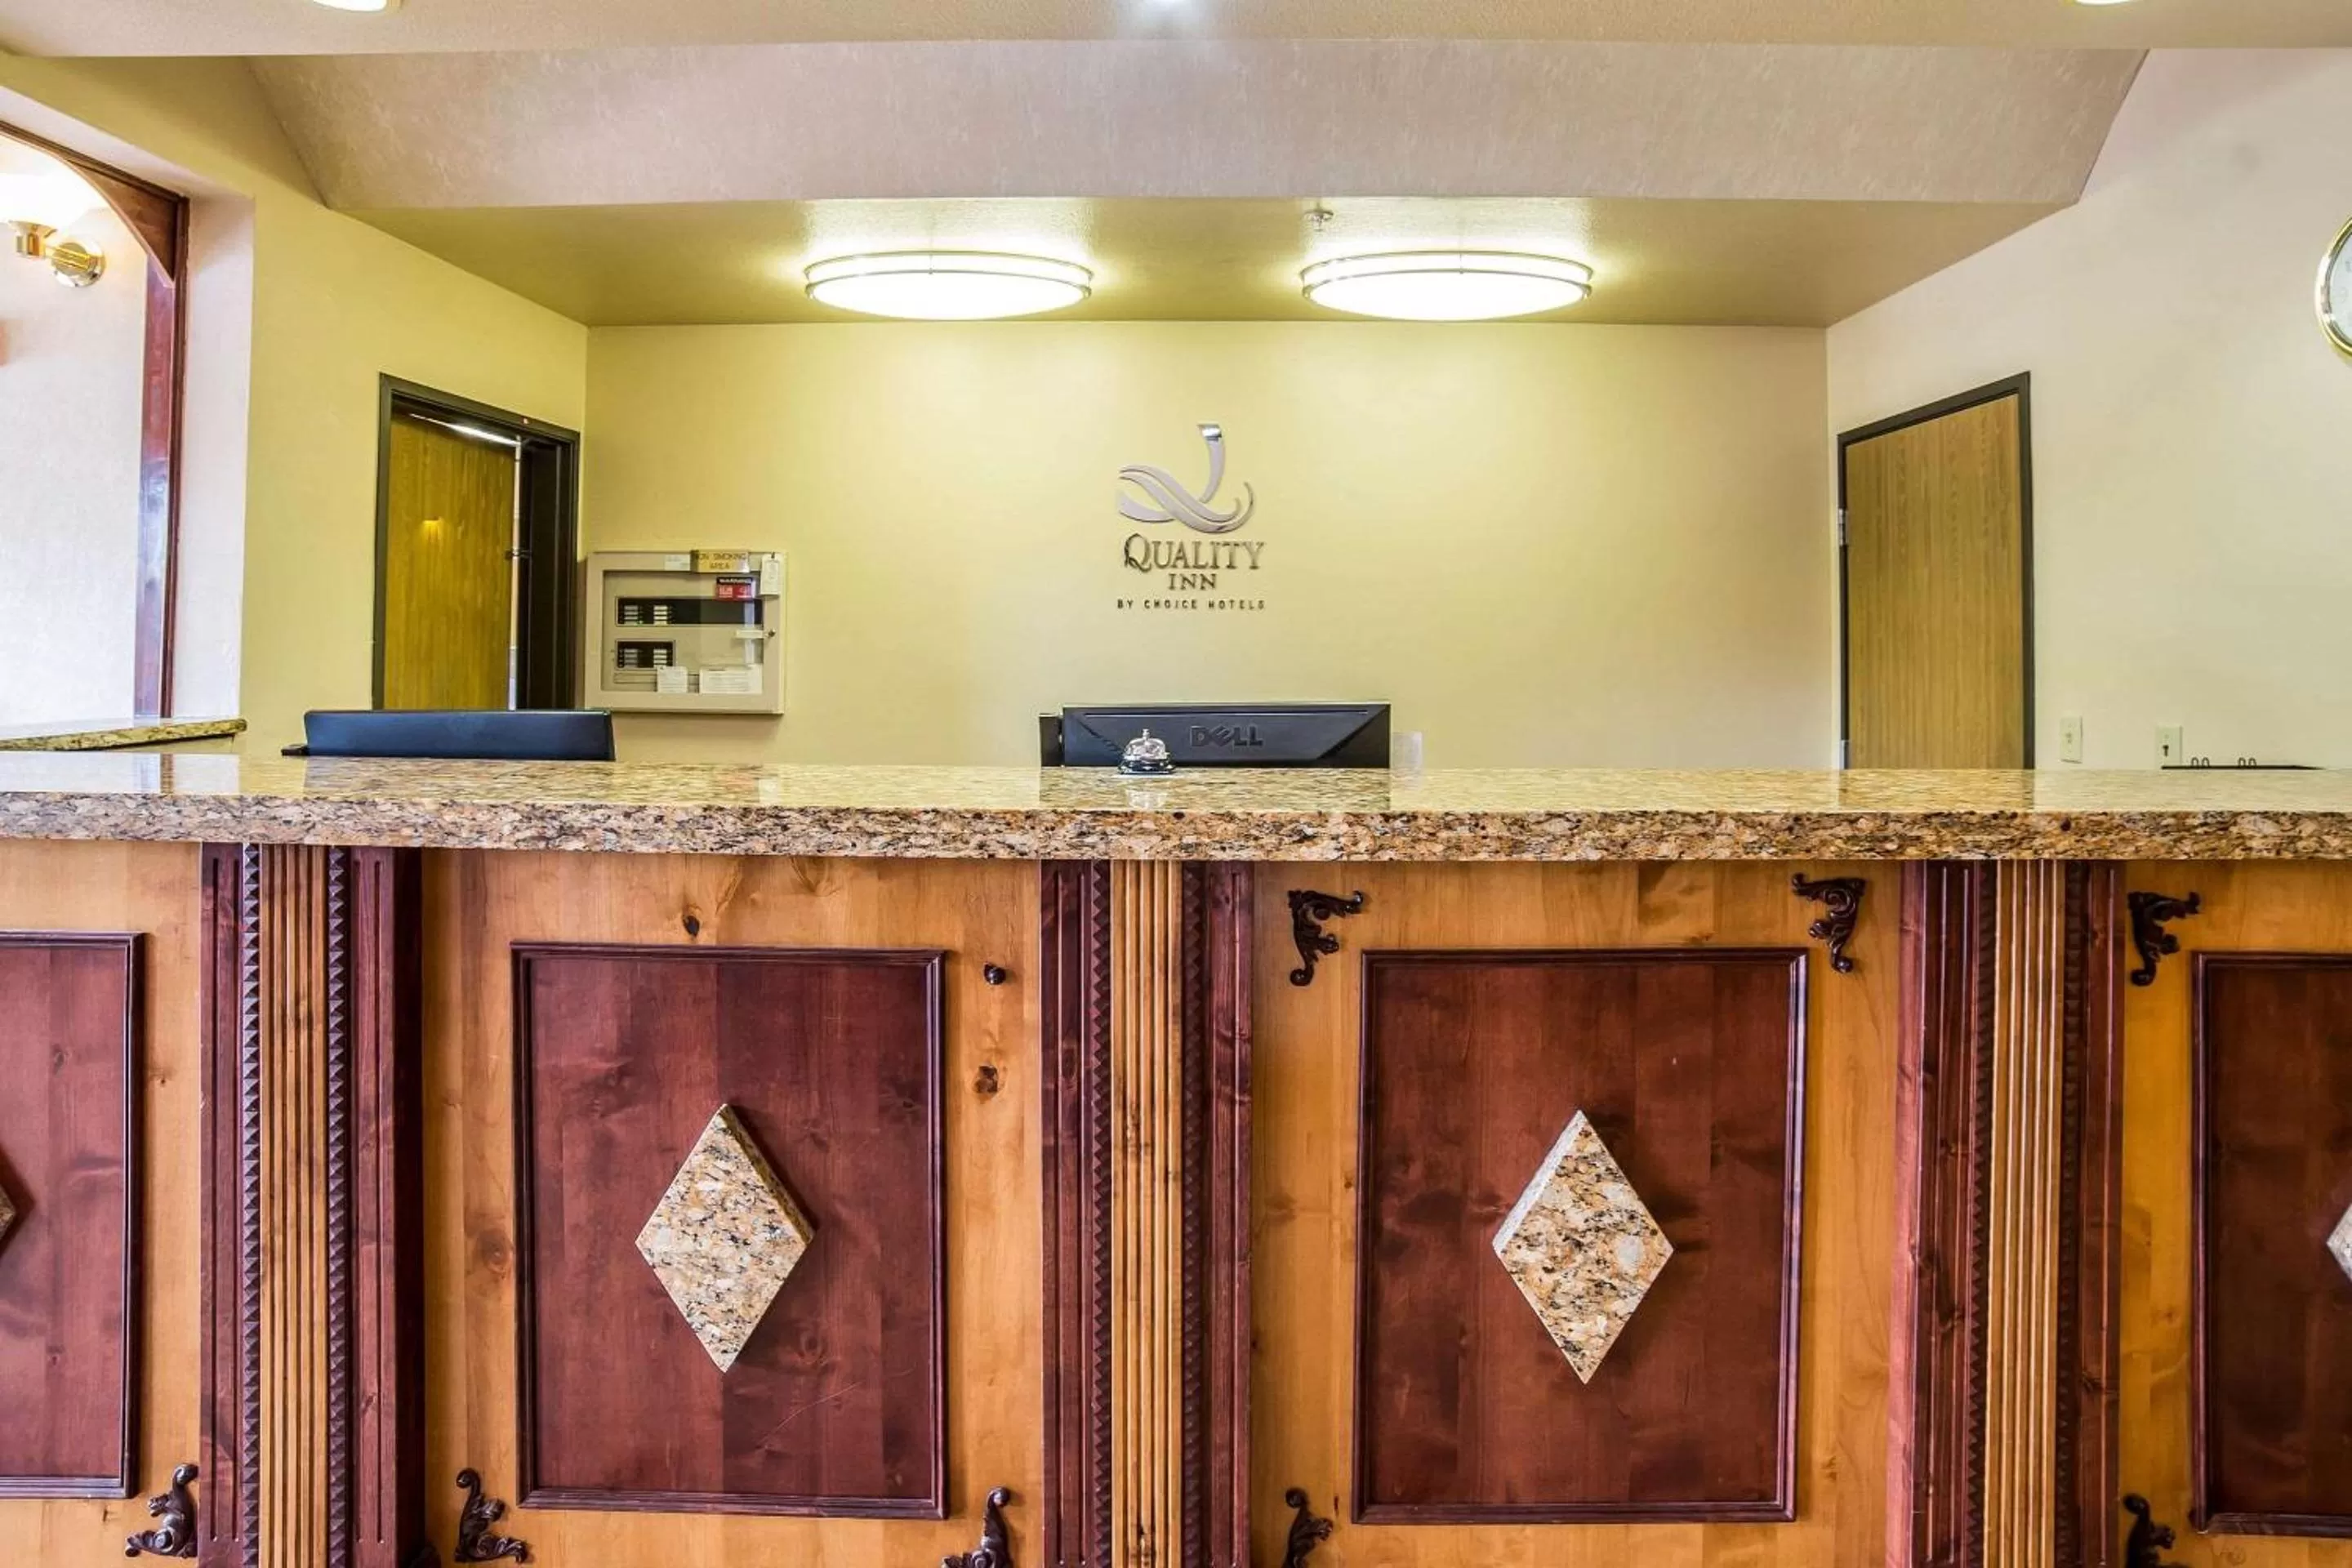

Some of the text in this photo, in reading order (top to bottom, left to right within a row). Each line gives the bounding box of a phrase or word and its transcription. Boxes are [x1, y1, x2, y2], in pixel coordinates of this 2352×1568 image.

[713, 552, 746, 561] SMOKING
[1124, 532, 1265, 572] QUALITY
[710, 562, 730, 570] AREA
[1168, 573, 1217, 590] INN
[1117, 599, 1265, 609] BY CHOICE HOTELS
[1190, 725, 1264, 747] DELL
